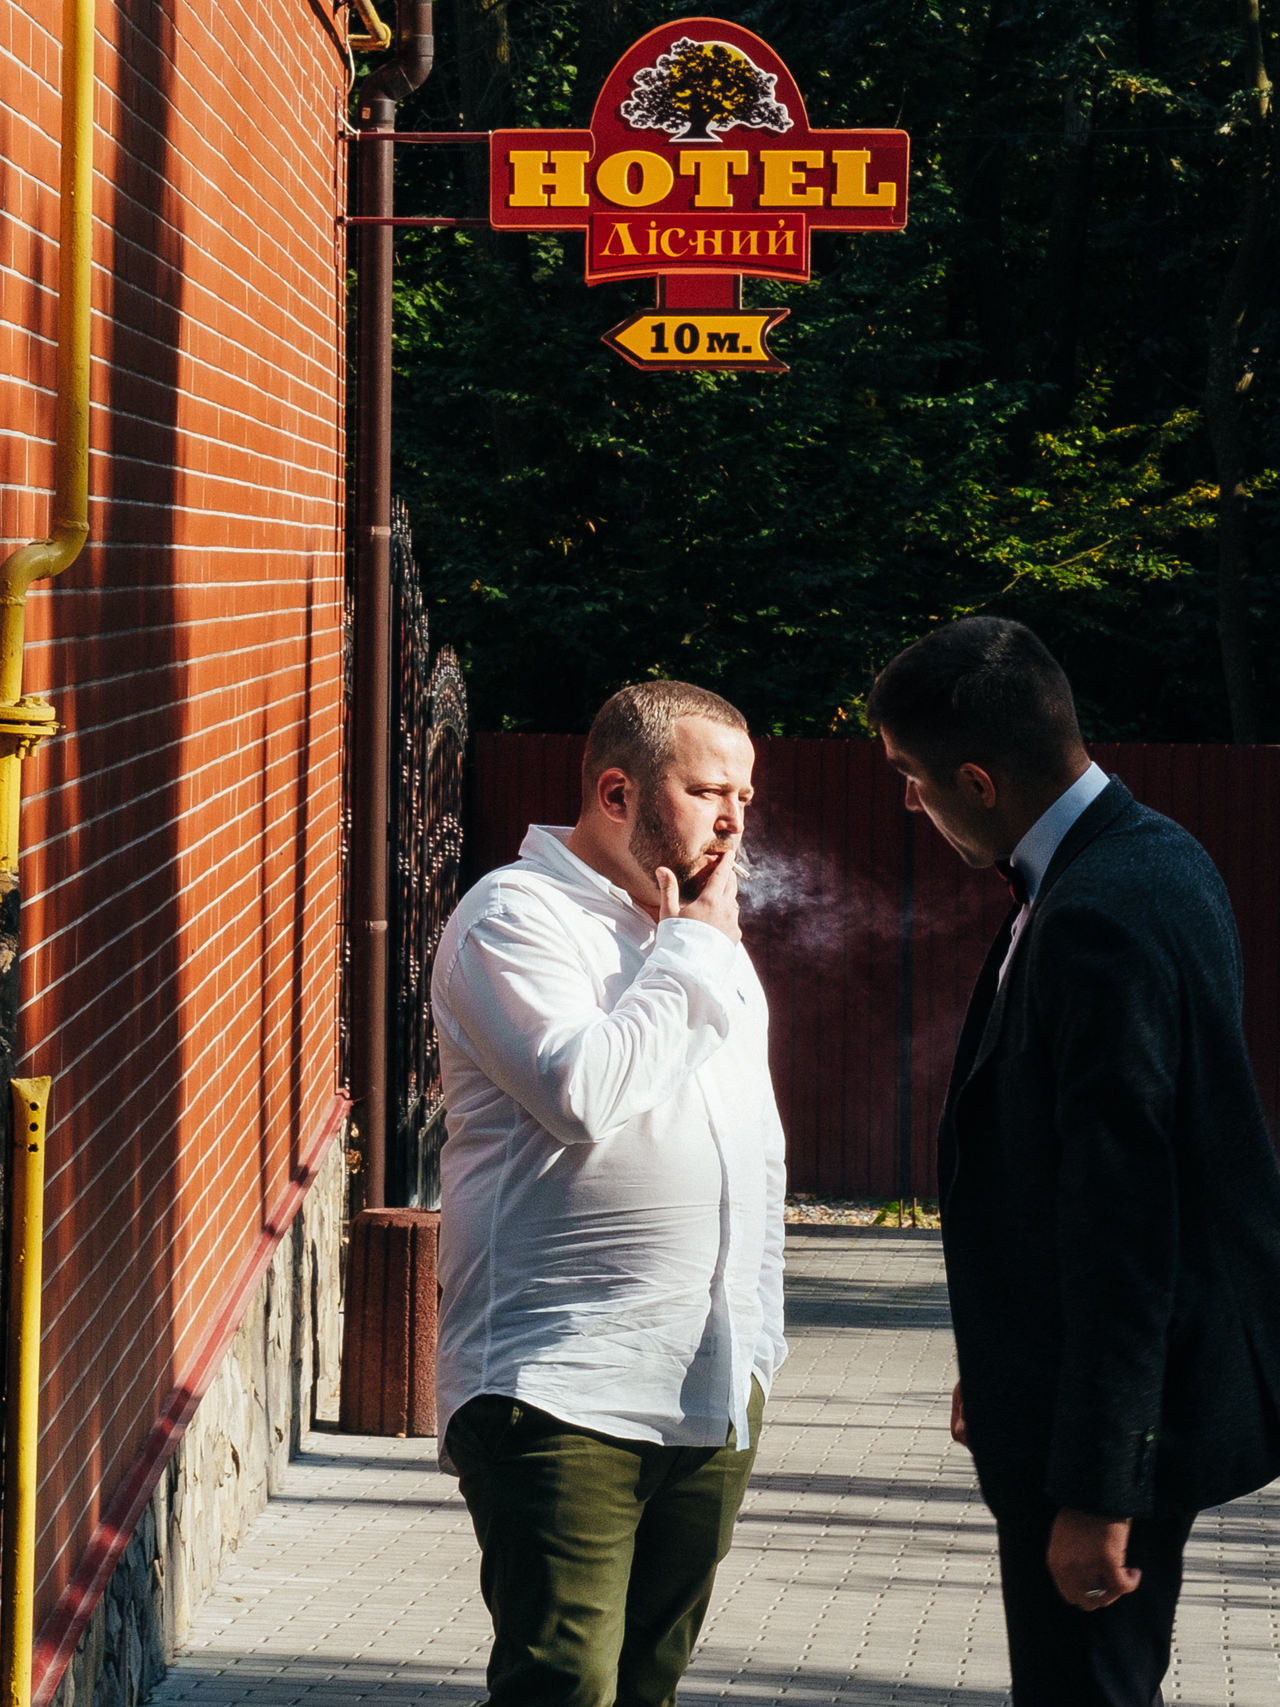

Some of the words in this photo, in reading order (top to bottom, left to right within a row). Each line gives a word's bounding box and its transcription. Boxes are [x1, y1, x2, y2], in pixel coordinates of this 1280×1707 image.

[509, 150, 897, 208] HOTEL
[599, 219, 799, 257] Лісний
[650, 323, 700, 354] 10
